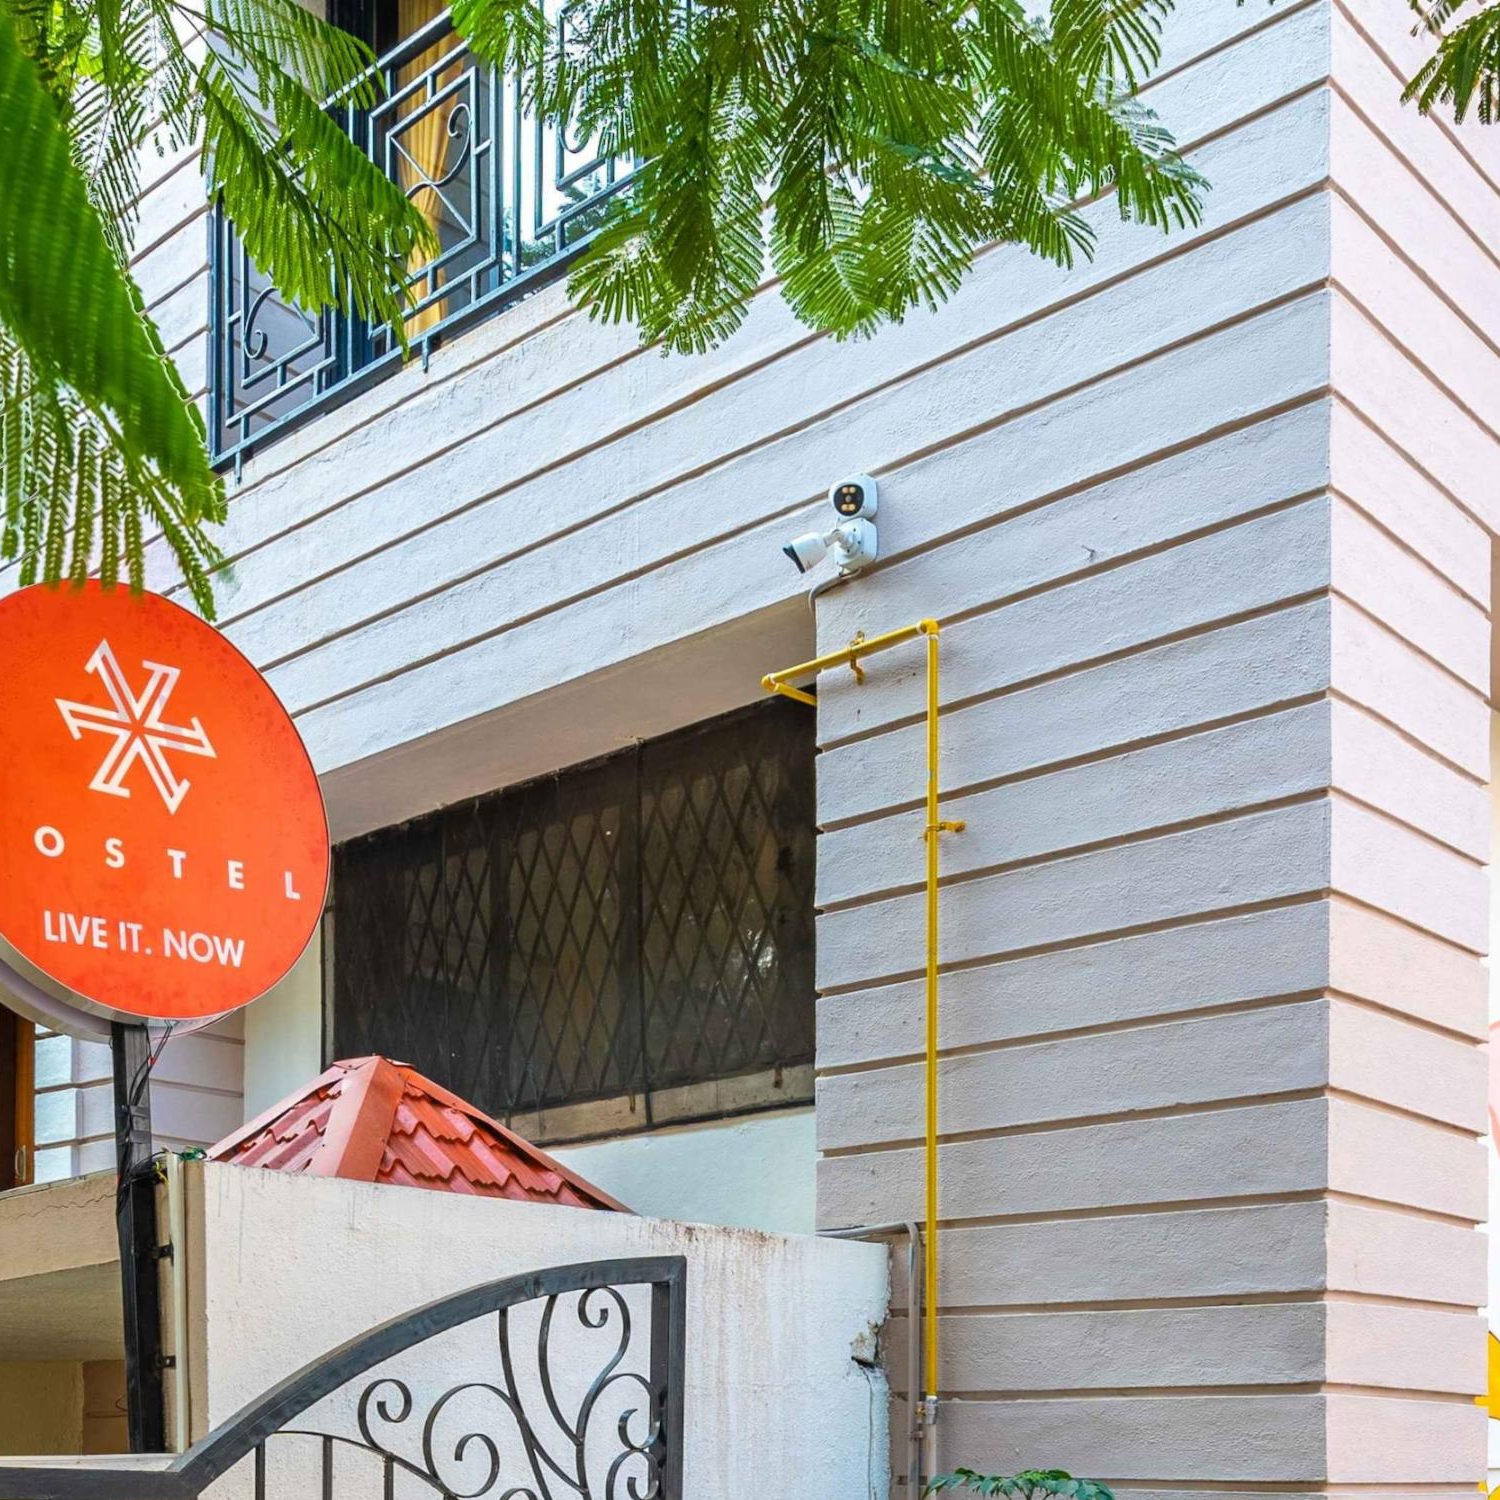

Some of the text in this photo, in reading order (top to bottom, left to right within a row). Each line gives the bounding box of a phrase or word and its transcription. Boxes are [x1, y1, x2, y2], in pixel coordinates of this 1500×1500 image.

[43, 910, 245, 968] LIVE IT. NOW
